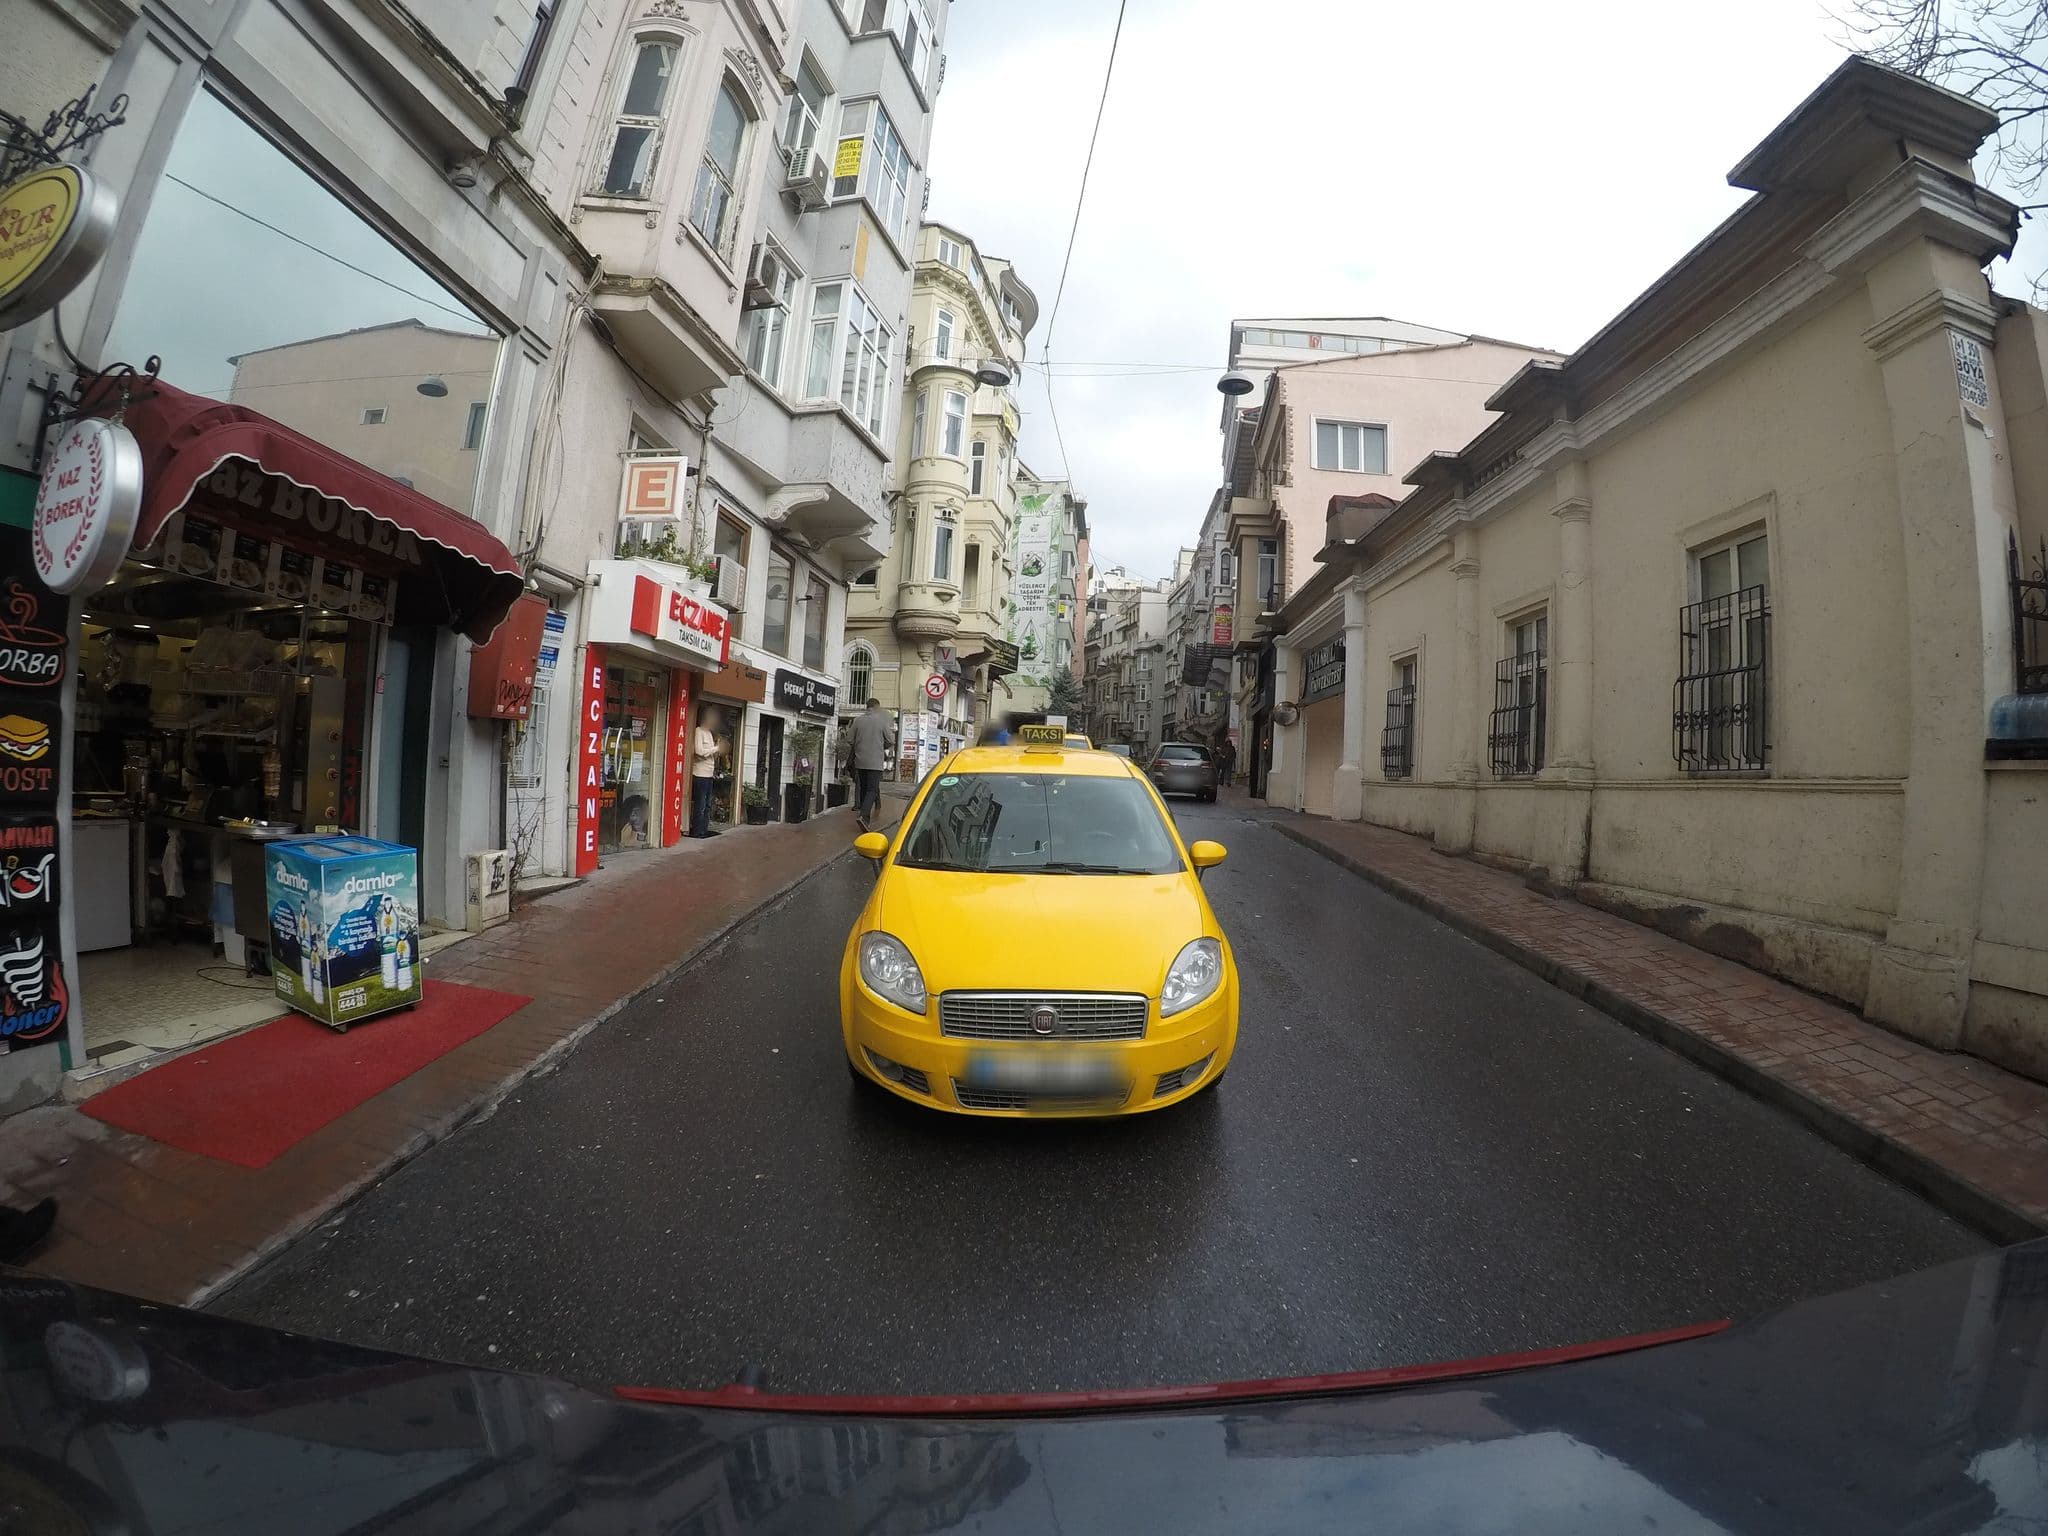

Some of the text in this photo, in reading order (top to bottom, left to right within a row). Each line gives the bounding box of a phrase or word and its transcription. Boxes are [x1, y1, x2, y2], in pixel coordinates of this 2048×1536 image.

[1956, 358, 1985, 382] BOYA
[56, 465, 82, 491] NAZ
[636, 470, 668, 507] E
[45, 495, 85, 526] BÖREK
[669, 590, 724, 642] ECZANE
[700, 638, 713, 653] CAN
[584, 666, 601, 852] ECZANE
[673, 689, 688, 829] PHARMACY
[0, 767, 51, 792] OST
[344, 872, 396, 893] damla
[1036, 1014, 1053, 1027] FIAT
